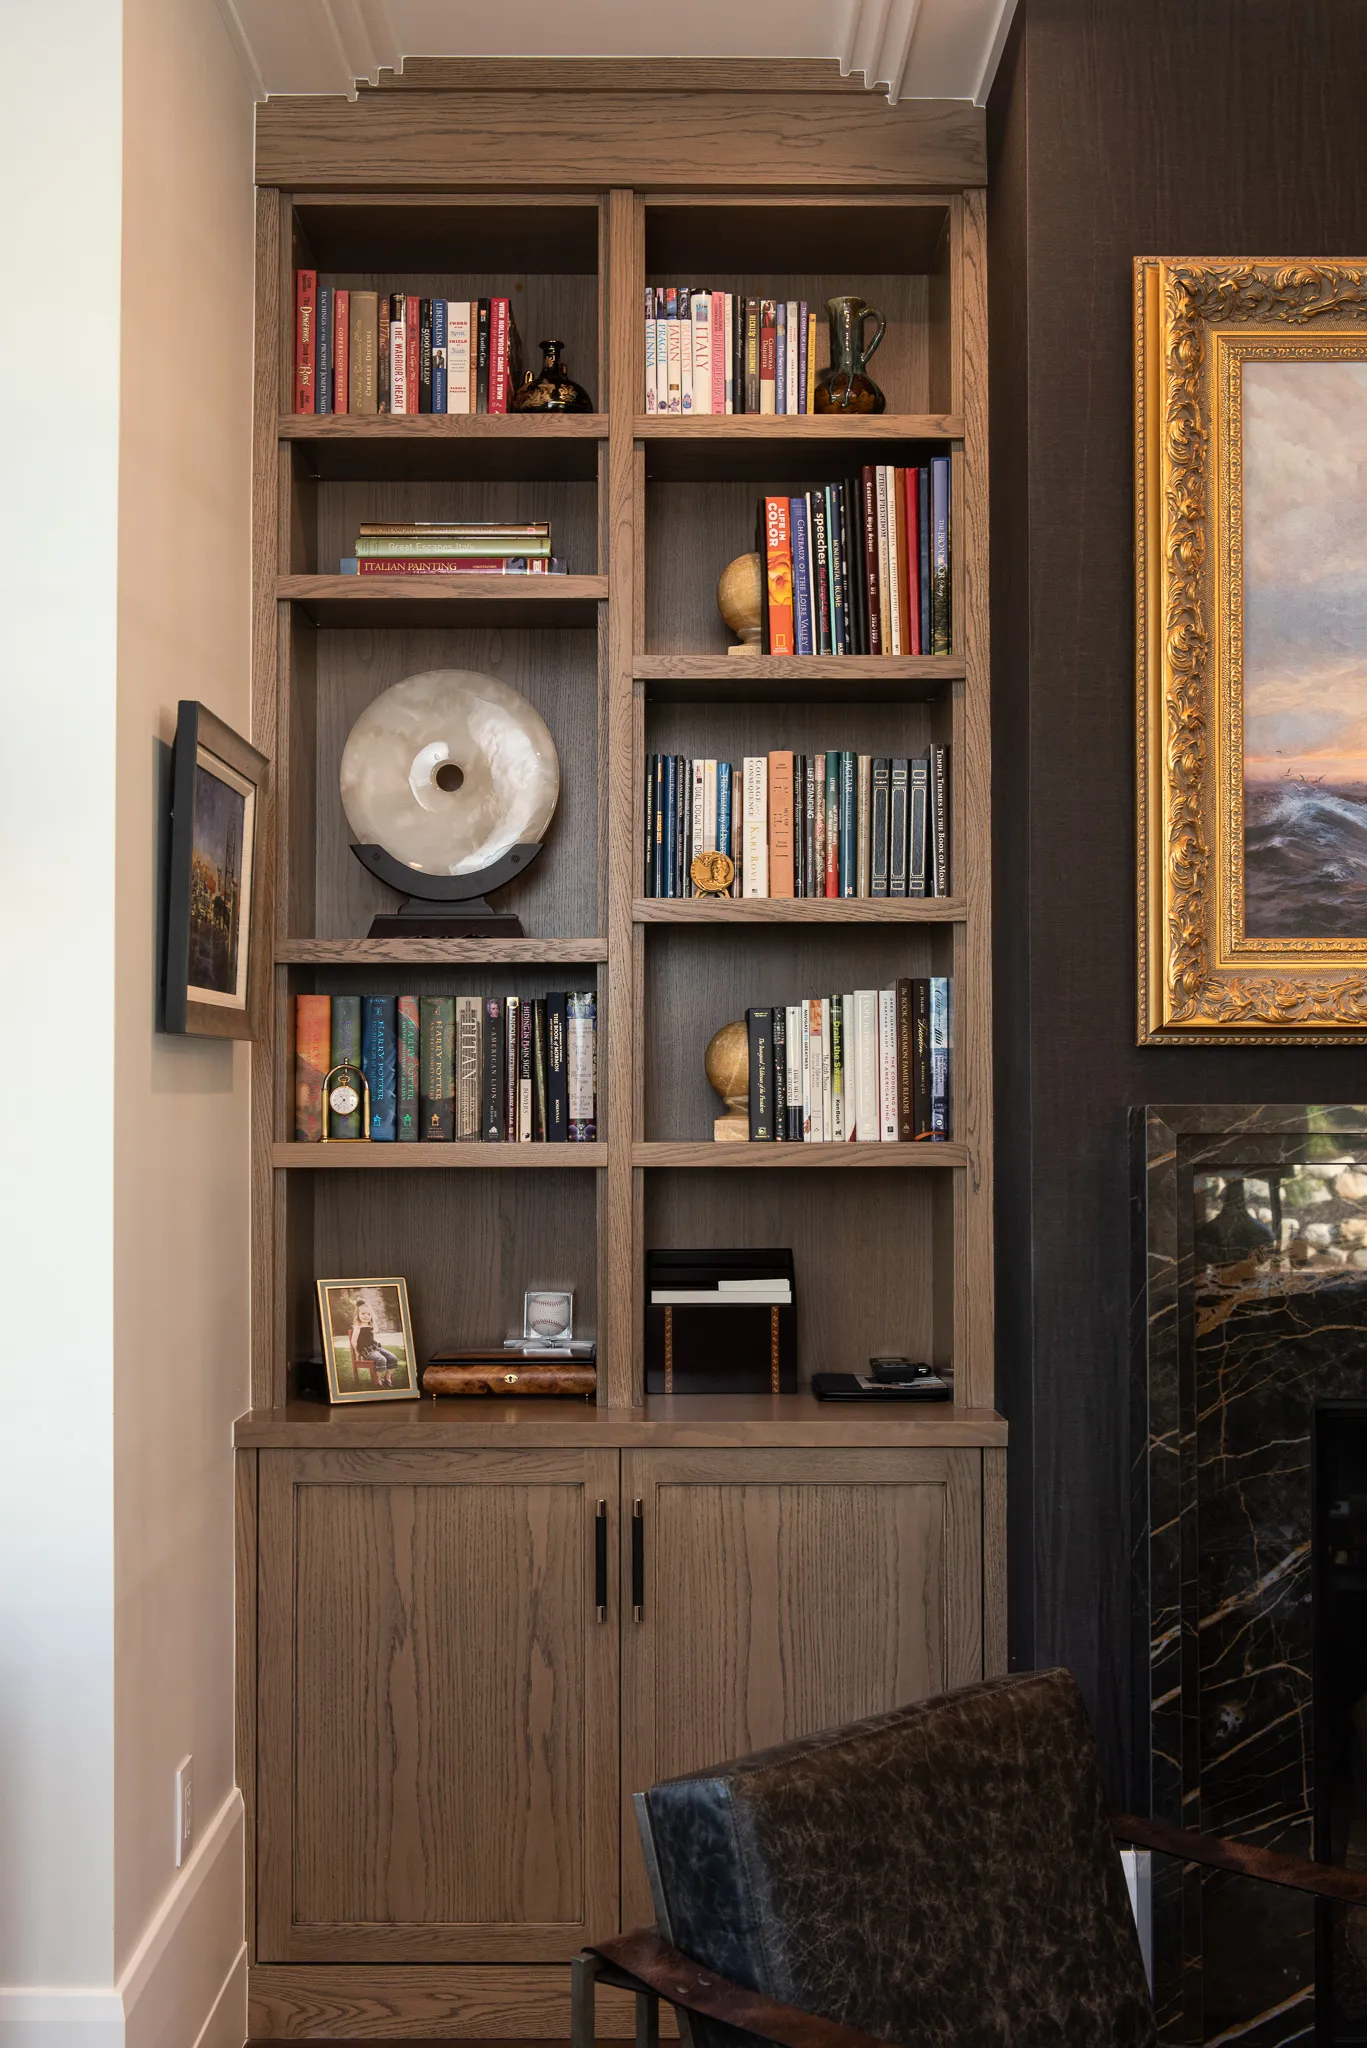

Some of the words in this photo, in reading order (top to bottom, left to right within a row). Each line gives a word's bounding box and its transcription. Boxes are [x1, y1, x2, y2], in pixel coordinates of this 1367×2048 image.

[380, 319, 389, 339] 1177
[395, 327, 403, 339] THE
[421, 328, 430, 349] 5000
[748, 314, 756, 337] RECKLESS
[658, 324, 666, 364] PRAGUE
[668, 325, 679, 361] JAPAN
[696, 327, 708, 371] ITALY
[395, 343, 404, 382] WARRIOR'S
[714, 334, 722, 399] PHILADELPHIA
[497, 374, 503, 382] TO
[395, 385, 403, 409] HEART
[768, 502, 779, 547] COLOR
[779, 531, 786, 540] IN
[388, 543, 412, 551] Great
[416, 543, 452, 553] Escapes
[456, 543, 475, 552] Italy
[796, 519, 806, 560] CHÂTEAUX
[813, 512, 826, 565] speeches
[364, 563, 405, 571] ITALIAN
[407, 563, 457, 571] PAINTING
[799, 563, 805, 572] OF
[938, 532, 946, 578] BROADMOOR
[800, 594, 808, 616] LOIRE
[819, 580, 827, 604] changed
[801, 619, 809, 646] VALLEY
[936, 749, 944, 776] TEMPLE
[844, 760, 853, 793] JAGUAR
[719, 790, 727, 822] Anatomy
[938, 808, 943, 816] IN
[750, 826, 758, 852] KARL
[750, 856, 759, 883] ROVE
[939, 855, 944, 863] OF
[523, 1031, 530, 1039] IN
[461, 1018, 477, 1081] TITAN
